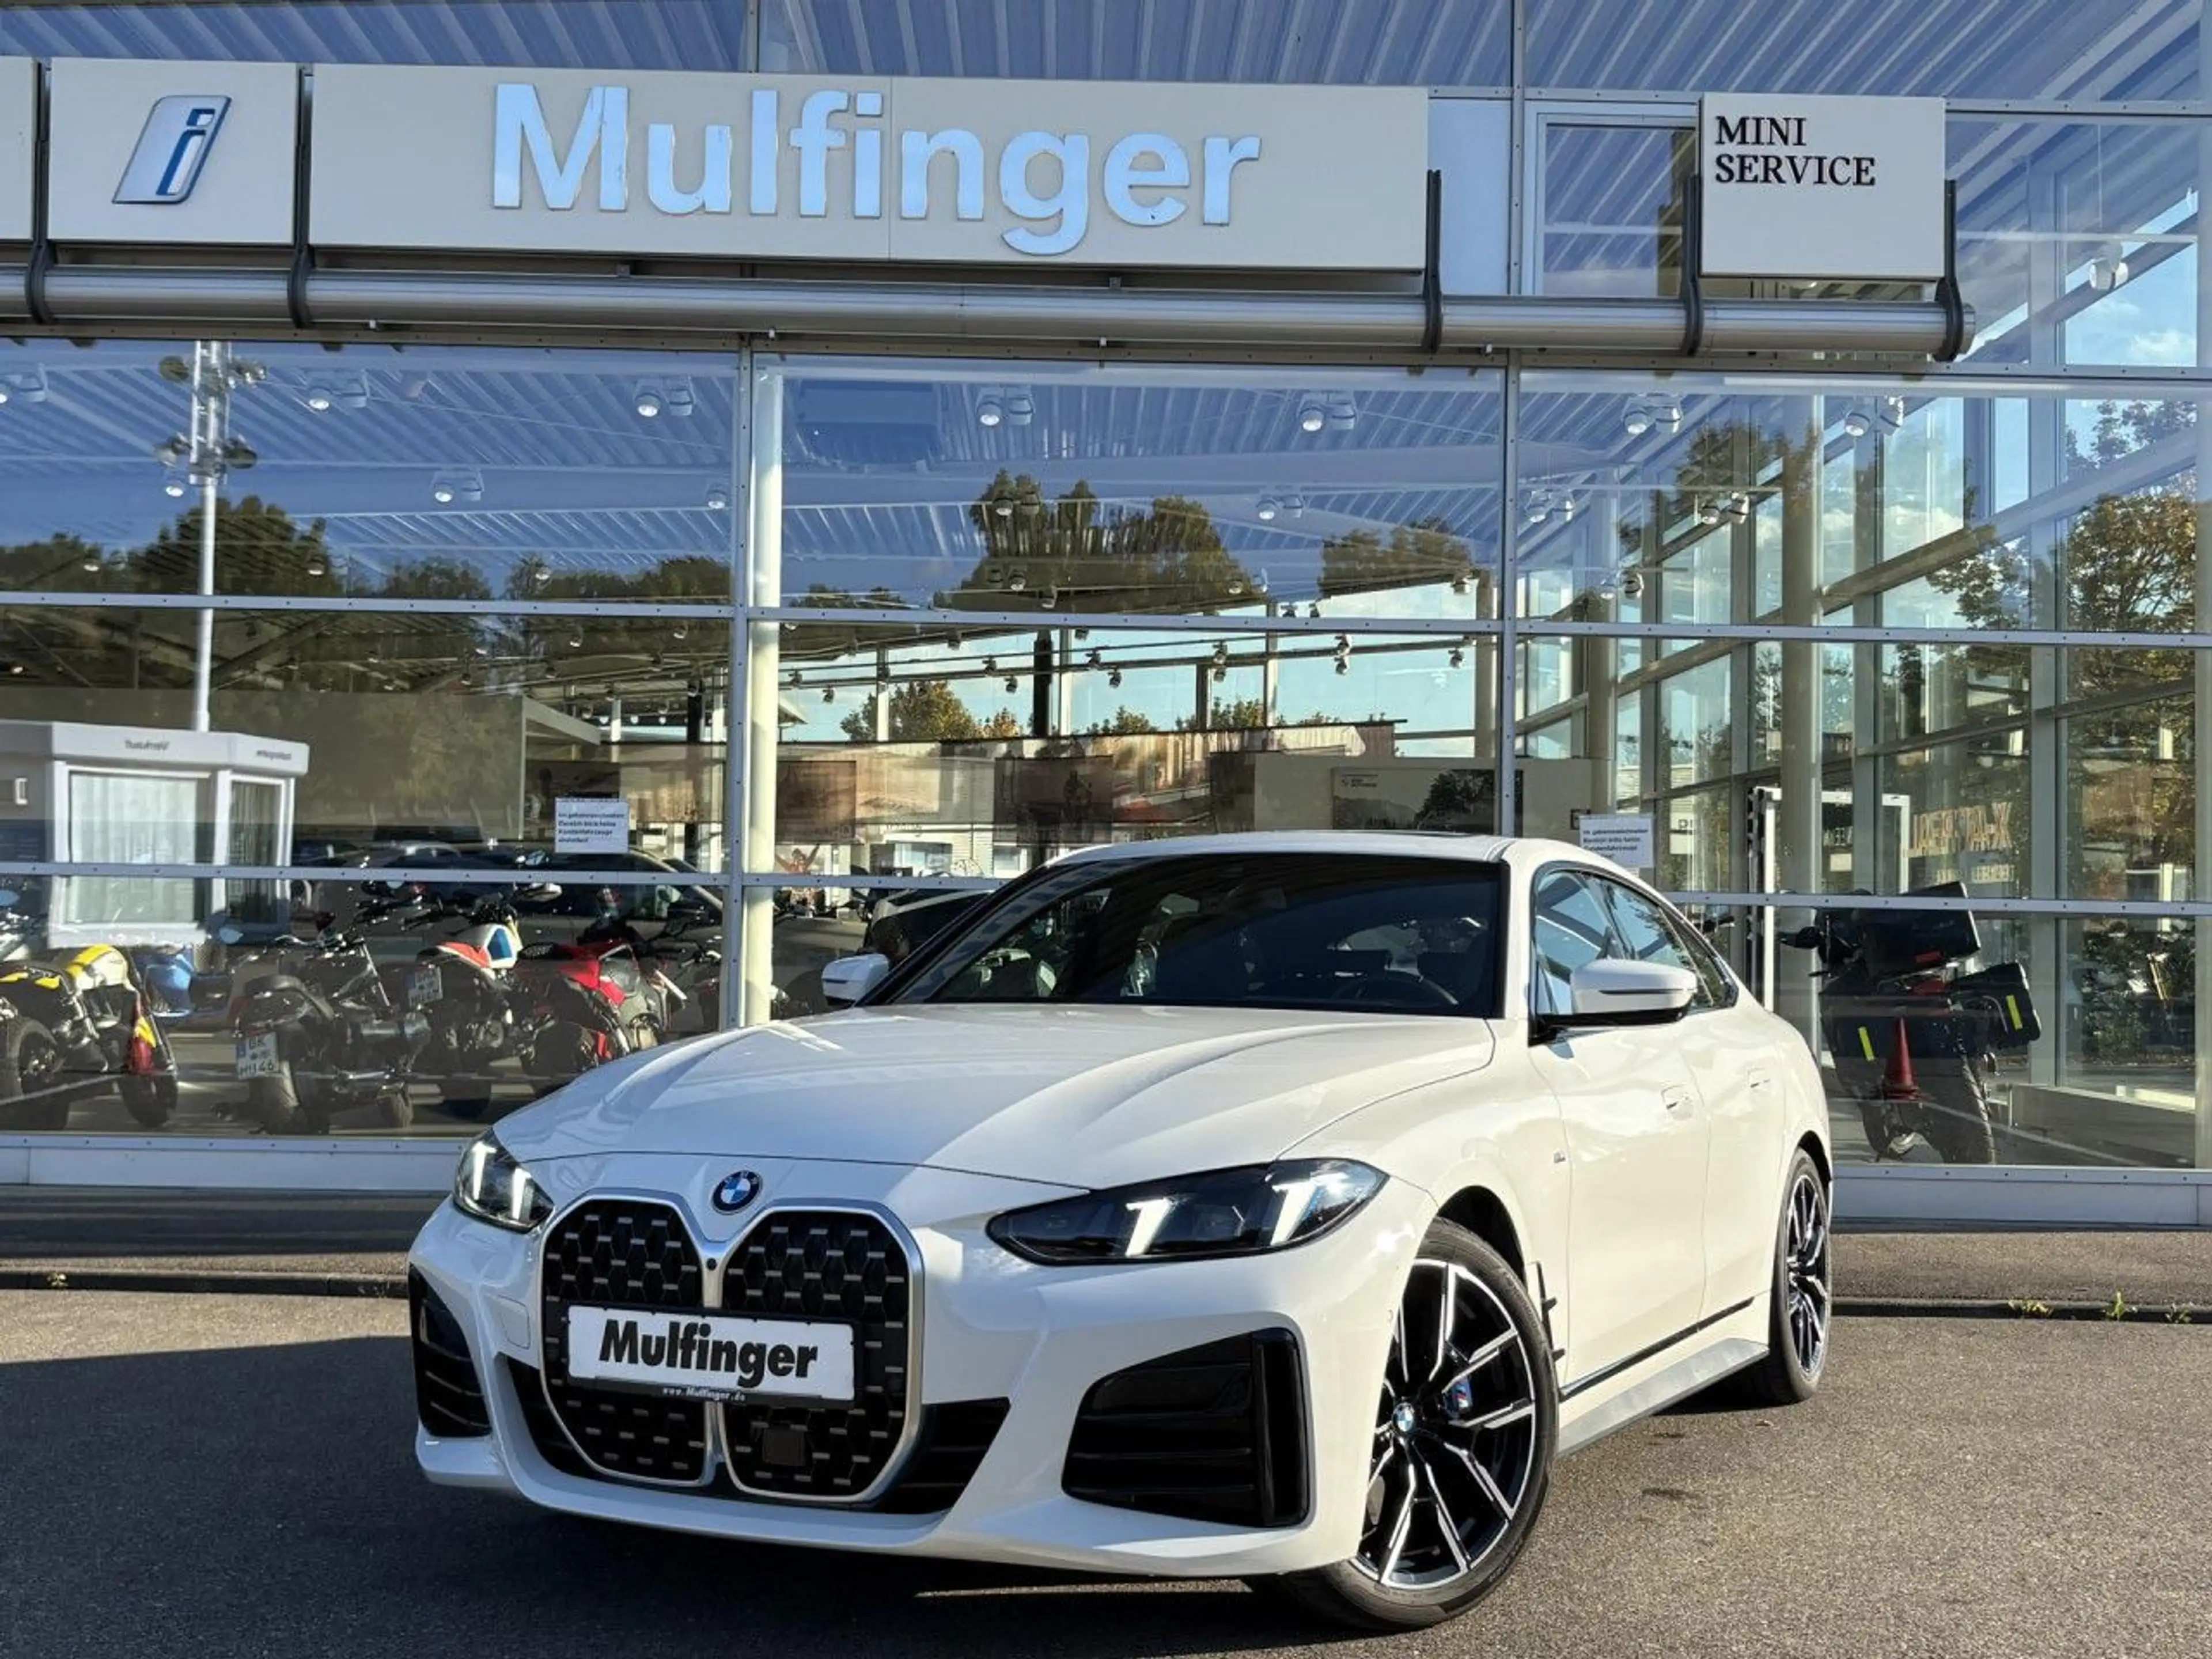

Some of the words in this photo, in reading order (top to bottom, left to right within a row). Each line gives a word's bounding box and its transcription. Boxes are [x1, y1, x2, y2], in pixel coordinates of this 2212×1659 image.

[1715, 115, 1808, 146] MINI
[492, 82, 1263, 257] Mulfinger
[1715, 153, 1876, 186] SERVICE
[599, 1319, 818, 1388] Mulfinger
